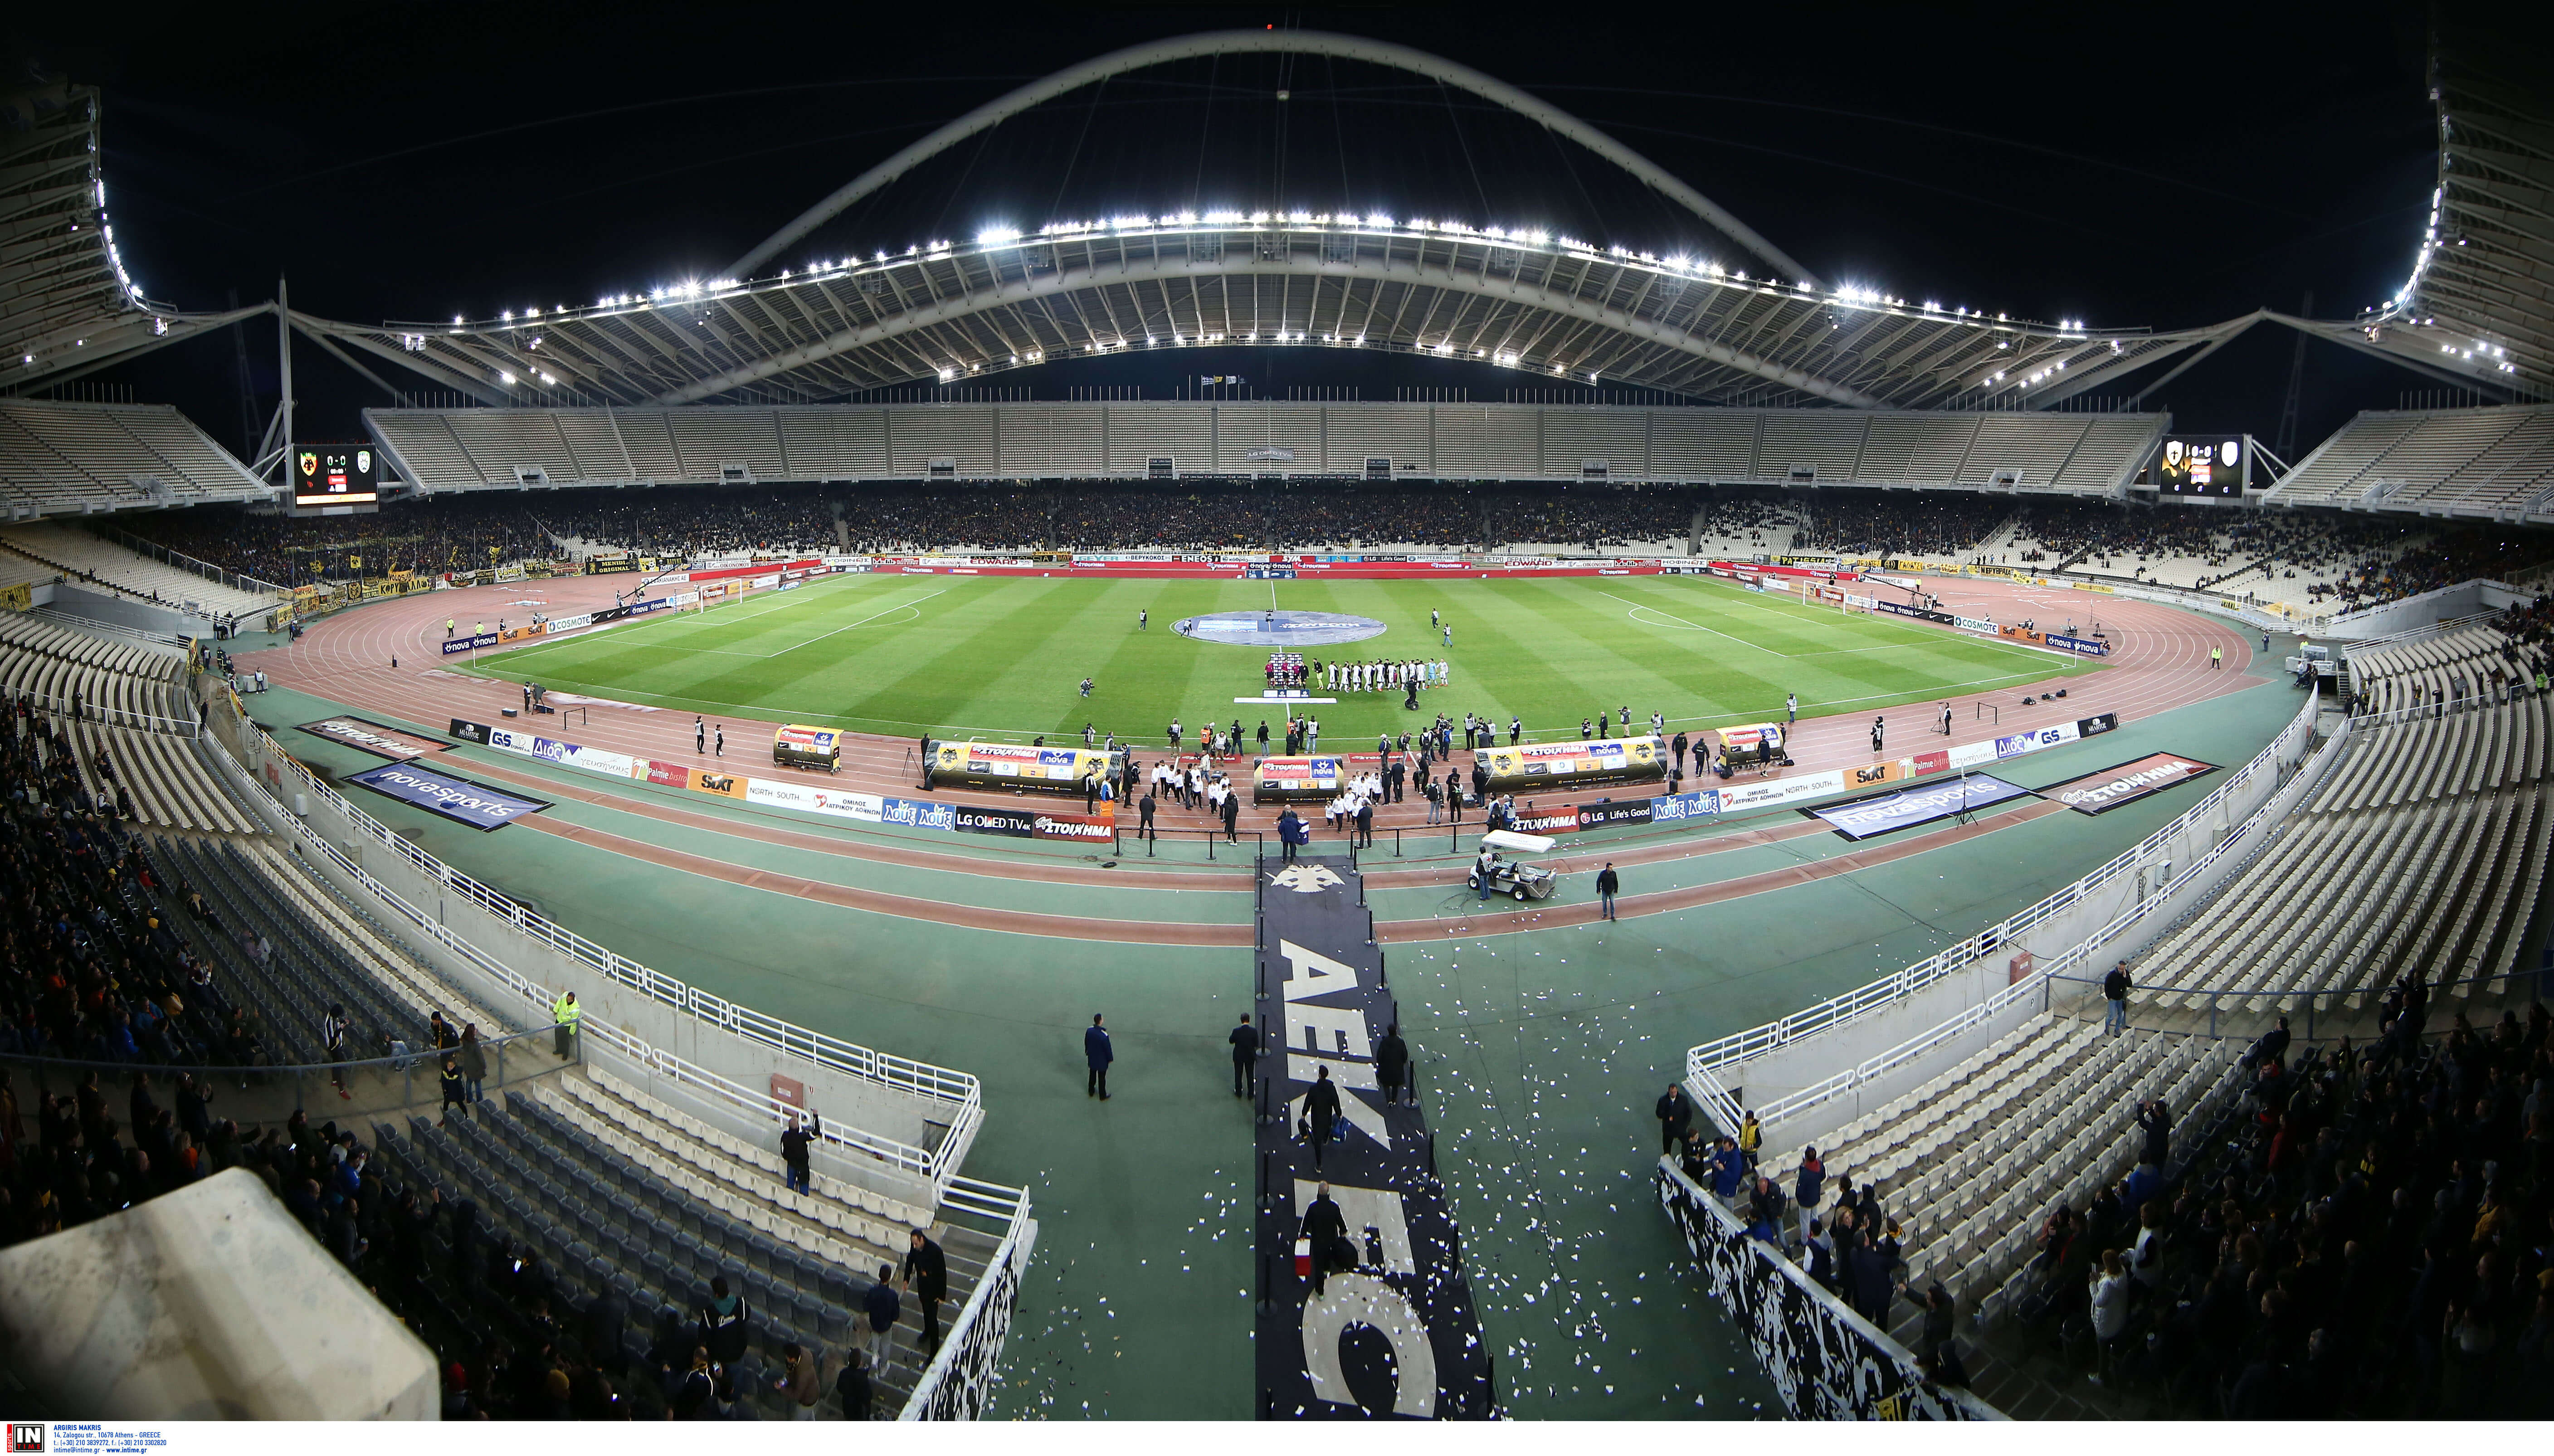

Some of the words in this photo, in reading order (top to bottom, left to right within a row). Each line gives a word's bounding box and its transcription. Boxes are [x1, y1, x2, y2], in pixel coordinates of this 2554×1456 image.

[497, 568, 522, 576] SAMOS
[637, 605, 648, 614] nova
[557, 615, 590, 629] COSMOTE
[1963, 619, 1997, 633] COSMOTE
[452, 641, 469, 650] nova
[480, 636, 496, 645] nova
[2054, 638, 2071, 648] nova
[2081, 643, 2099, 654] nova
[534, 740, 562, 762] Διός
[980, 747, 1038, 758] ΣΤΟΙΧΗΜΑ
[1531, 745, 1587, 756] ΣΤΟΙΧΗΜΑ
[1999, 738, 2024, 755] Διός
[1045, 756, 1068, 764] nova
[1914, 761, 1933, 771] Palmie
[1934, 757, 1950, 767] bistro
[1950, 750, 1995, 767] γευσήνους
[580, 757, 629, 776] γευσήνους
[648, 767, 669, 780] Palmie
[669, 772, 687, 783] bistro
[2091, 761, 2194, 803] ΣΤΟΙΧΗΜΑ
[380, 769, 514, 818] novasports
[1786, 784, 1808, 794] NORTH
[1812, 780, 1833, 790] SOUTH
[750, 787, 772, 797] NORTH
[777, 791, 799, 802] SOUTH
[1733, 797, 1758, 805] ΙΑΤΡΙΚΟΥ
[1760, 792, 1784, 801] ΑΘΗΝΩΝ
[826, 803, 853, 812] ΙΑΤΡΙΚΟΥ
[855, 808, 881, 816] ΑΘΗΝΩΝ
[1592, 812, 1604, 823] LG
[1610, 808, 1629, 820] Life's
[1631, 806, 1650, 818] Good
[957, 814, 972, 826] LG
[975, 816, 1006, 829] OLED
[1008, 818, 1023, 830] TV
[1513, 815, 1576, 832] ΣΤΟΙΧΗΜΑ
[1045, 822, 1111, 837] ΣΤΟΙΧΗΜΑ
[1280, 939, 1391, 1151] AEK
[1293, 1178, 1437, 1418] FC
